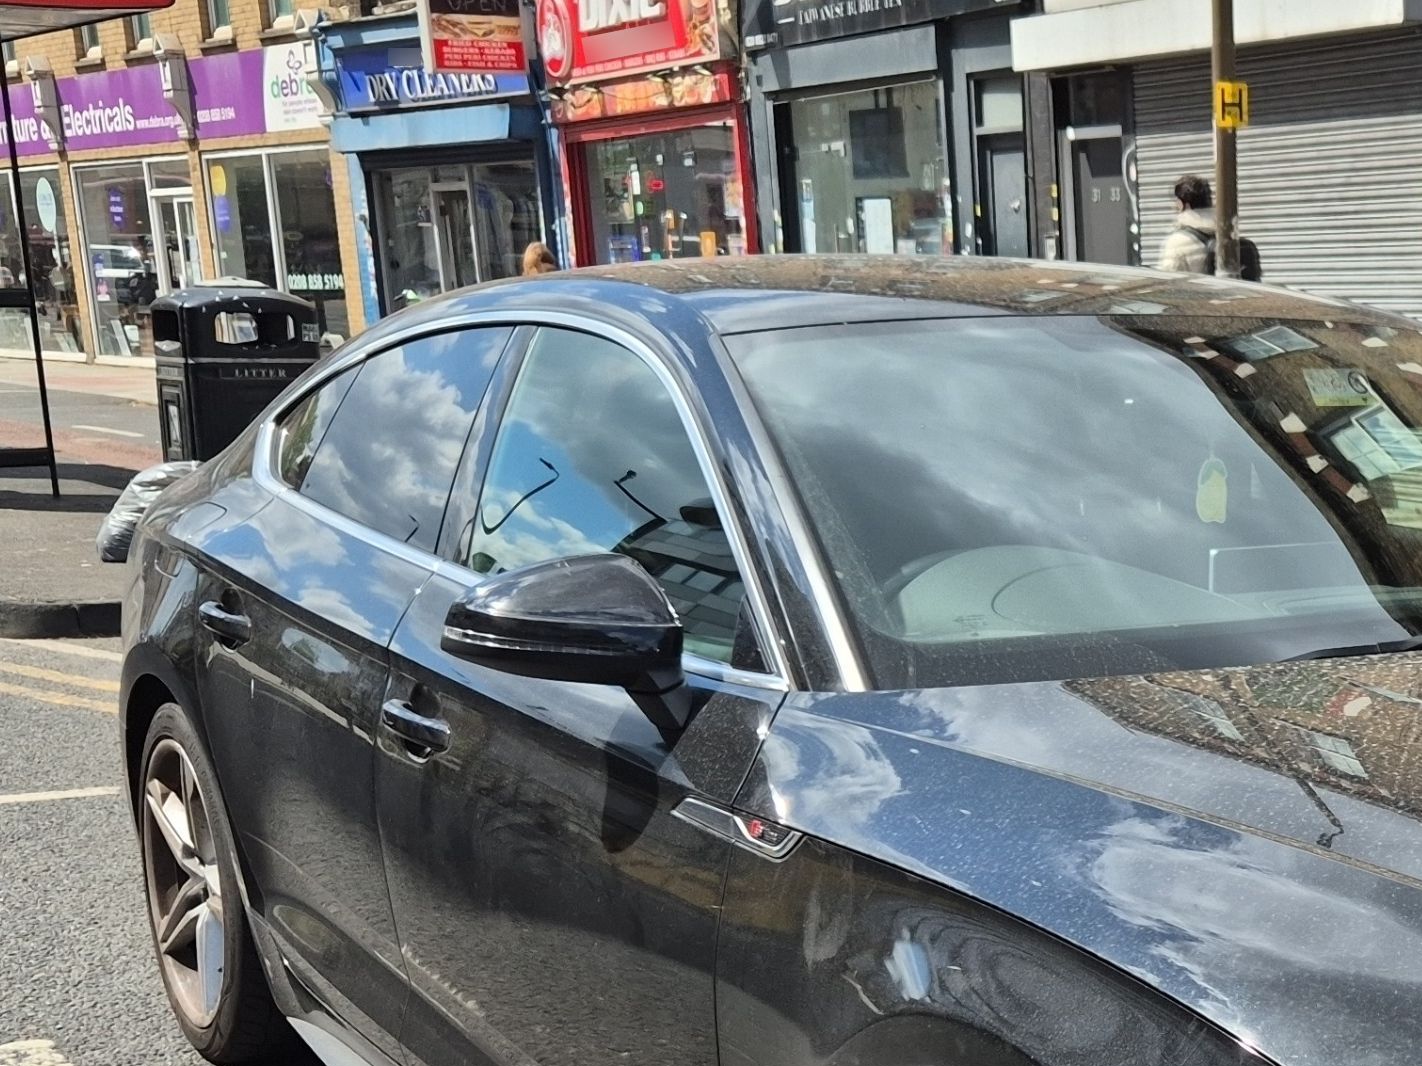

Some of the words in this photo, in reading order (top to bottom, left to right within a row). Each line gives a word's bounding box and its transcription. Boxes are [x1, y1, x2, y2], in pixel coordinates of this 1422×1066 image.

[366, 72, 398, 102] DRY
[402, 68, 498, 100] CLEANERS
[63, 97, 135, 137] Electricals
[1220, 87, 1244, 122] H
[234, 367, 288, 379] LITTER
